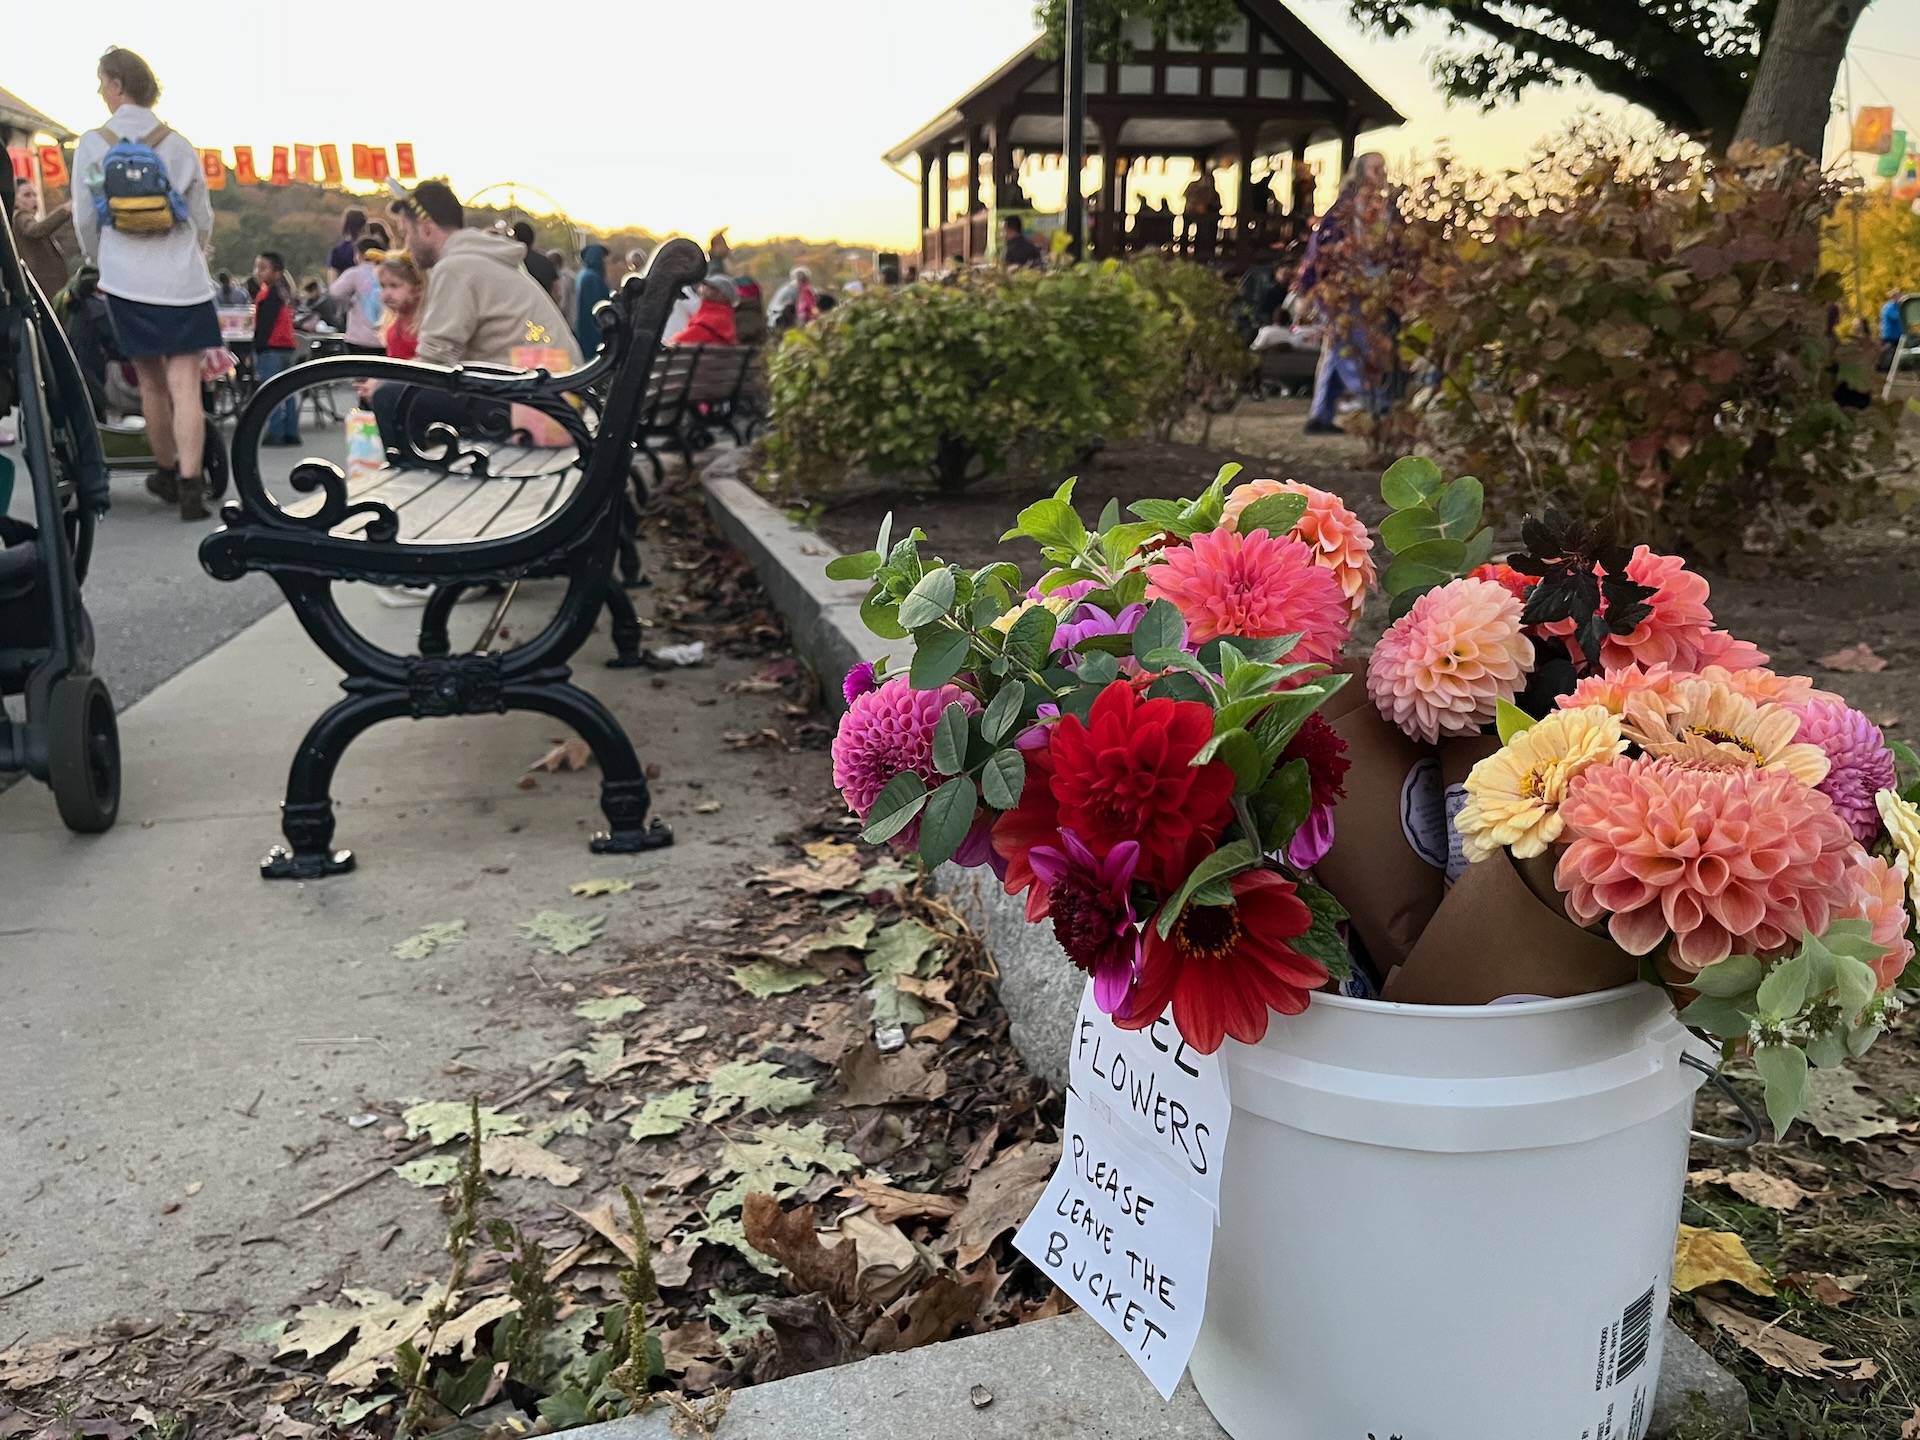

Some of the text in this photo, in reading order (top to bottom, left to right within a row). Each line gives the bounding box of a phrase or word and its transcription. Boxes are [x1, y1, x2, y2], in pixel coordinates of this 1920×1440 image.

[1079, 1014, 1210, 1175] FLOWERS
[1072, 1134, 1155, 1226] PLEASE
[1044, 1231, 1167, 1360] BUCKET.
[1057, 1188, 1176, 1311] LEAVE THE
[1610, 1319, 1620, 1350] WHITE
